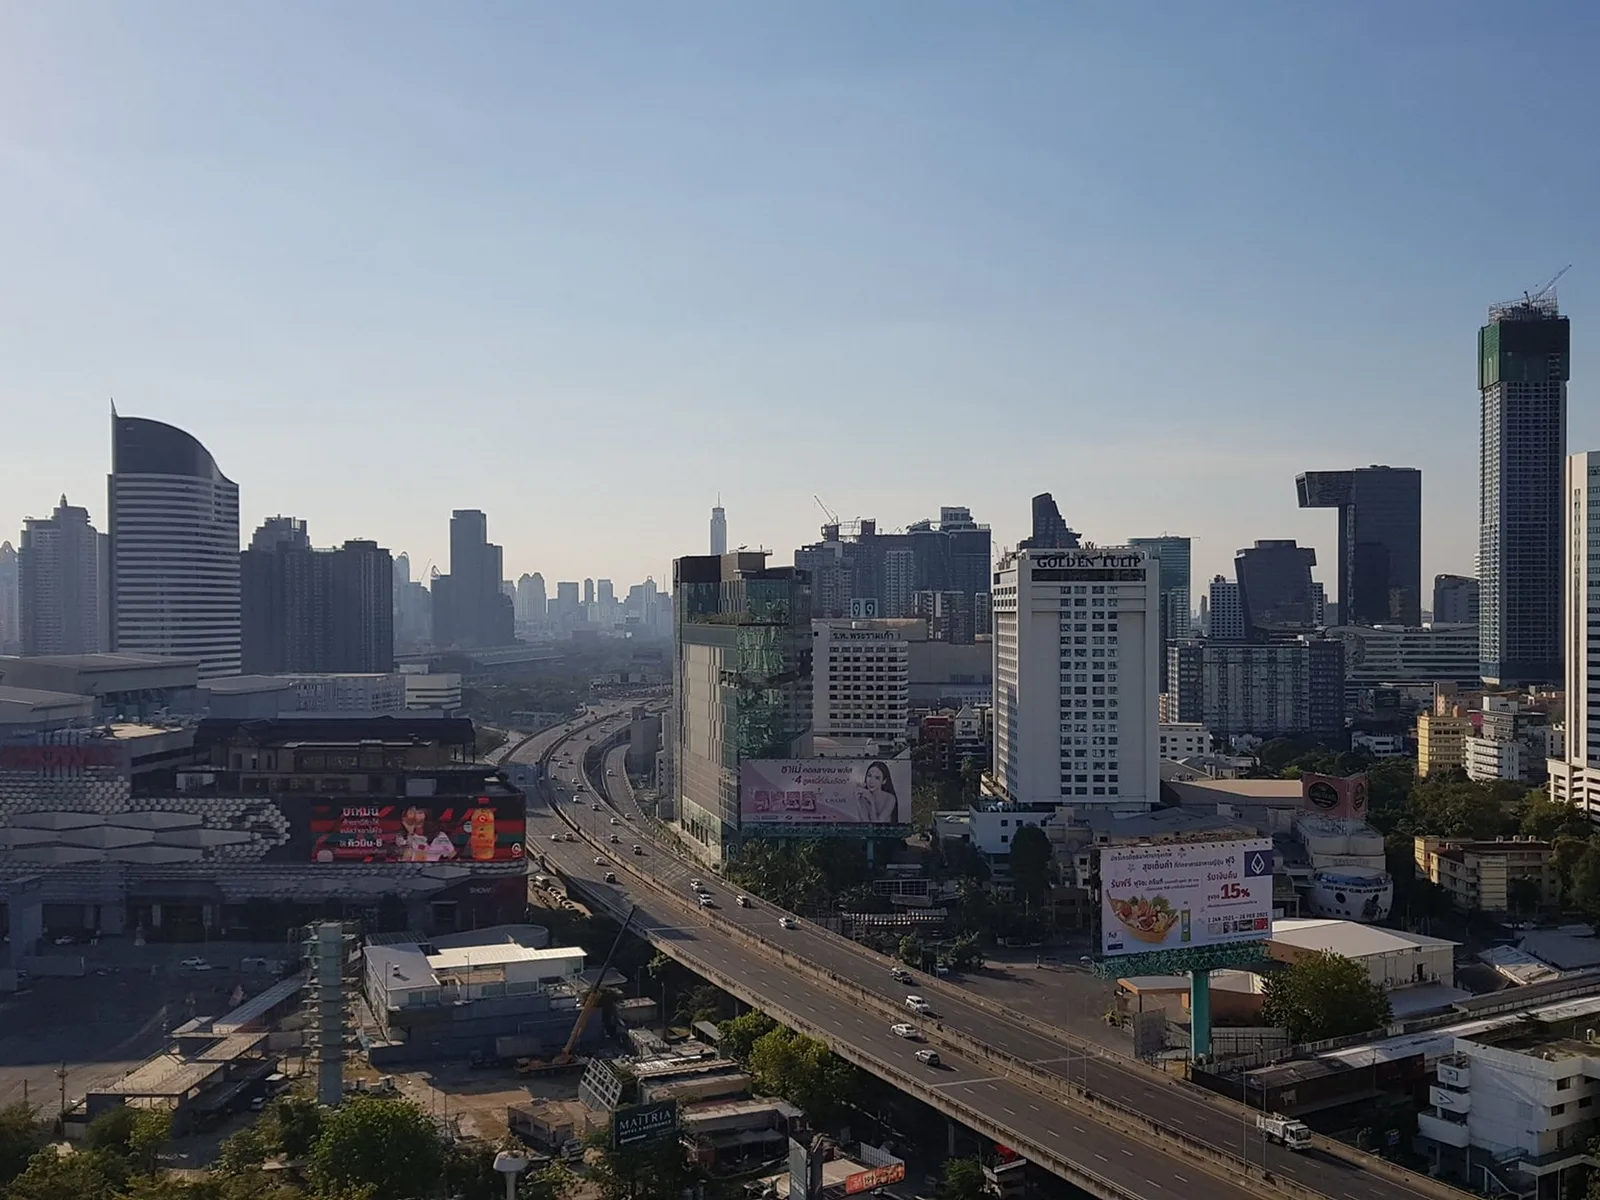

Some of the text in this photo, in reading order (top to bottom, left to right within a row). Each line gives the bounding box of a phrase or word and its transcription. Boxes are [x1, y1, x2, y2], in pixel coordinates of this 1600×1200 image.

[1037, 555, 1141, 568] GOLDEN TULIP
[1221, 882, 1250, 900] 15%
[619, 1108, 671, 1130] MAITRIA
